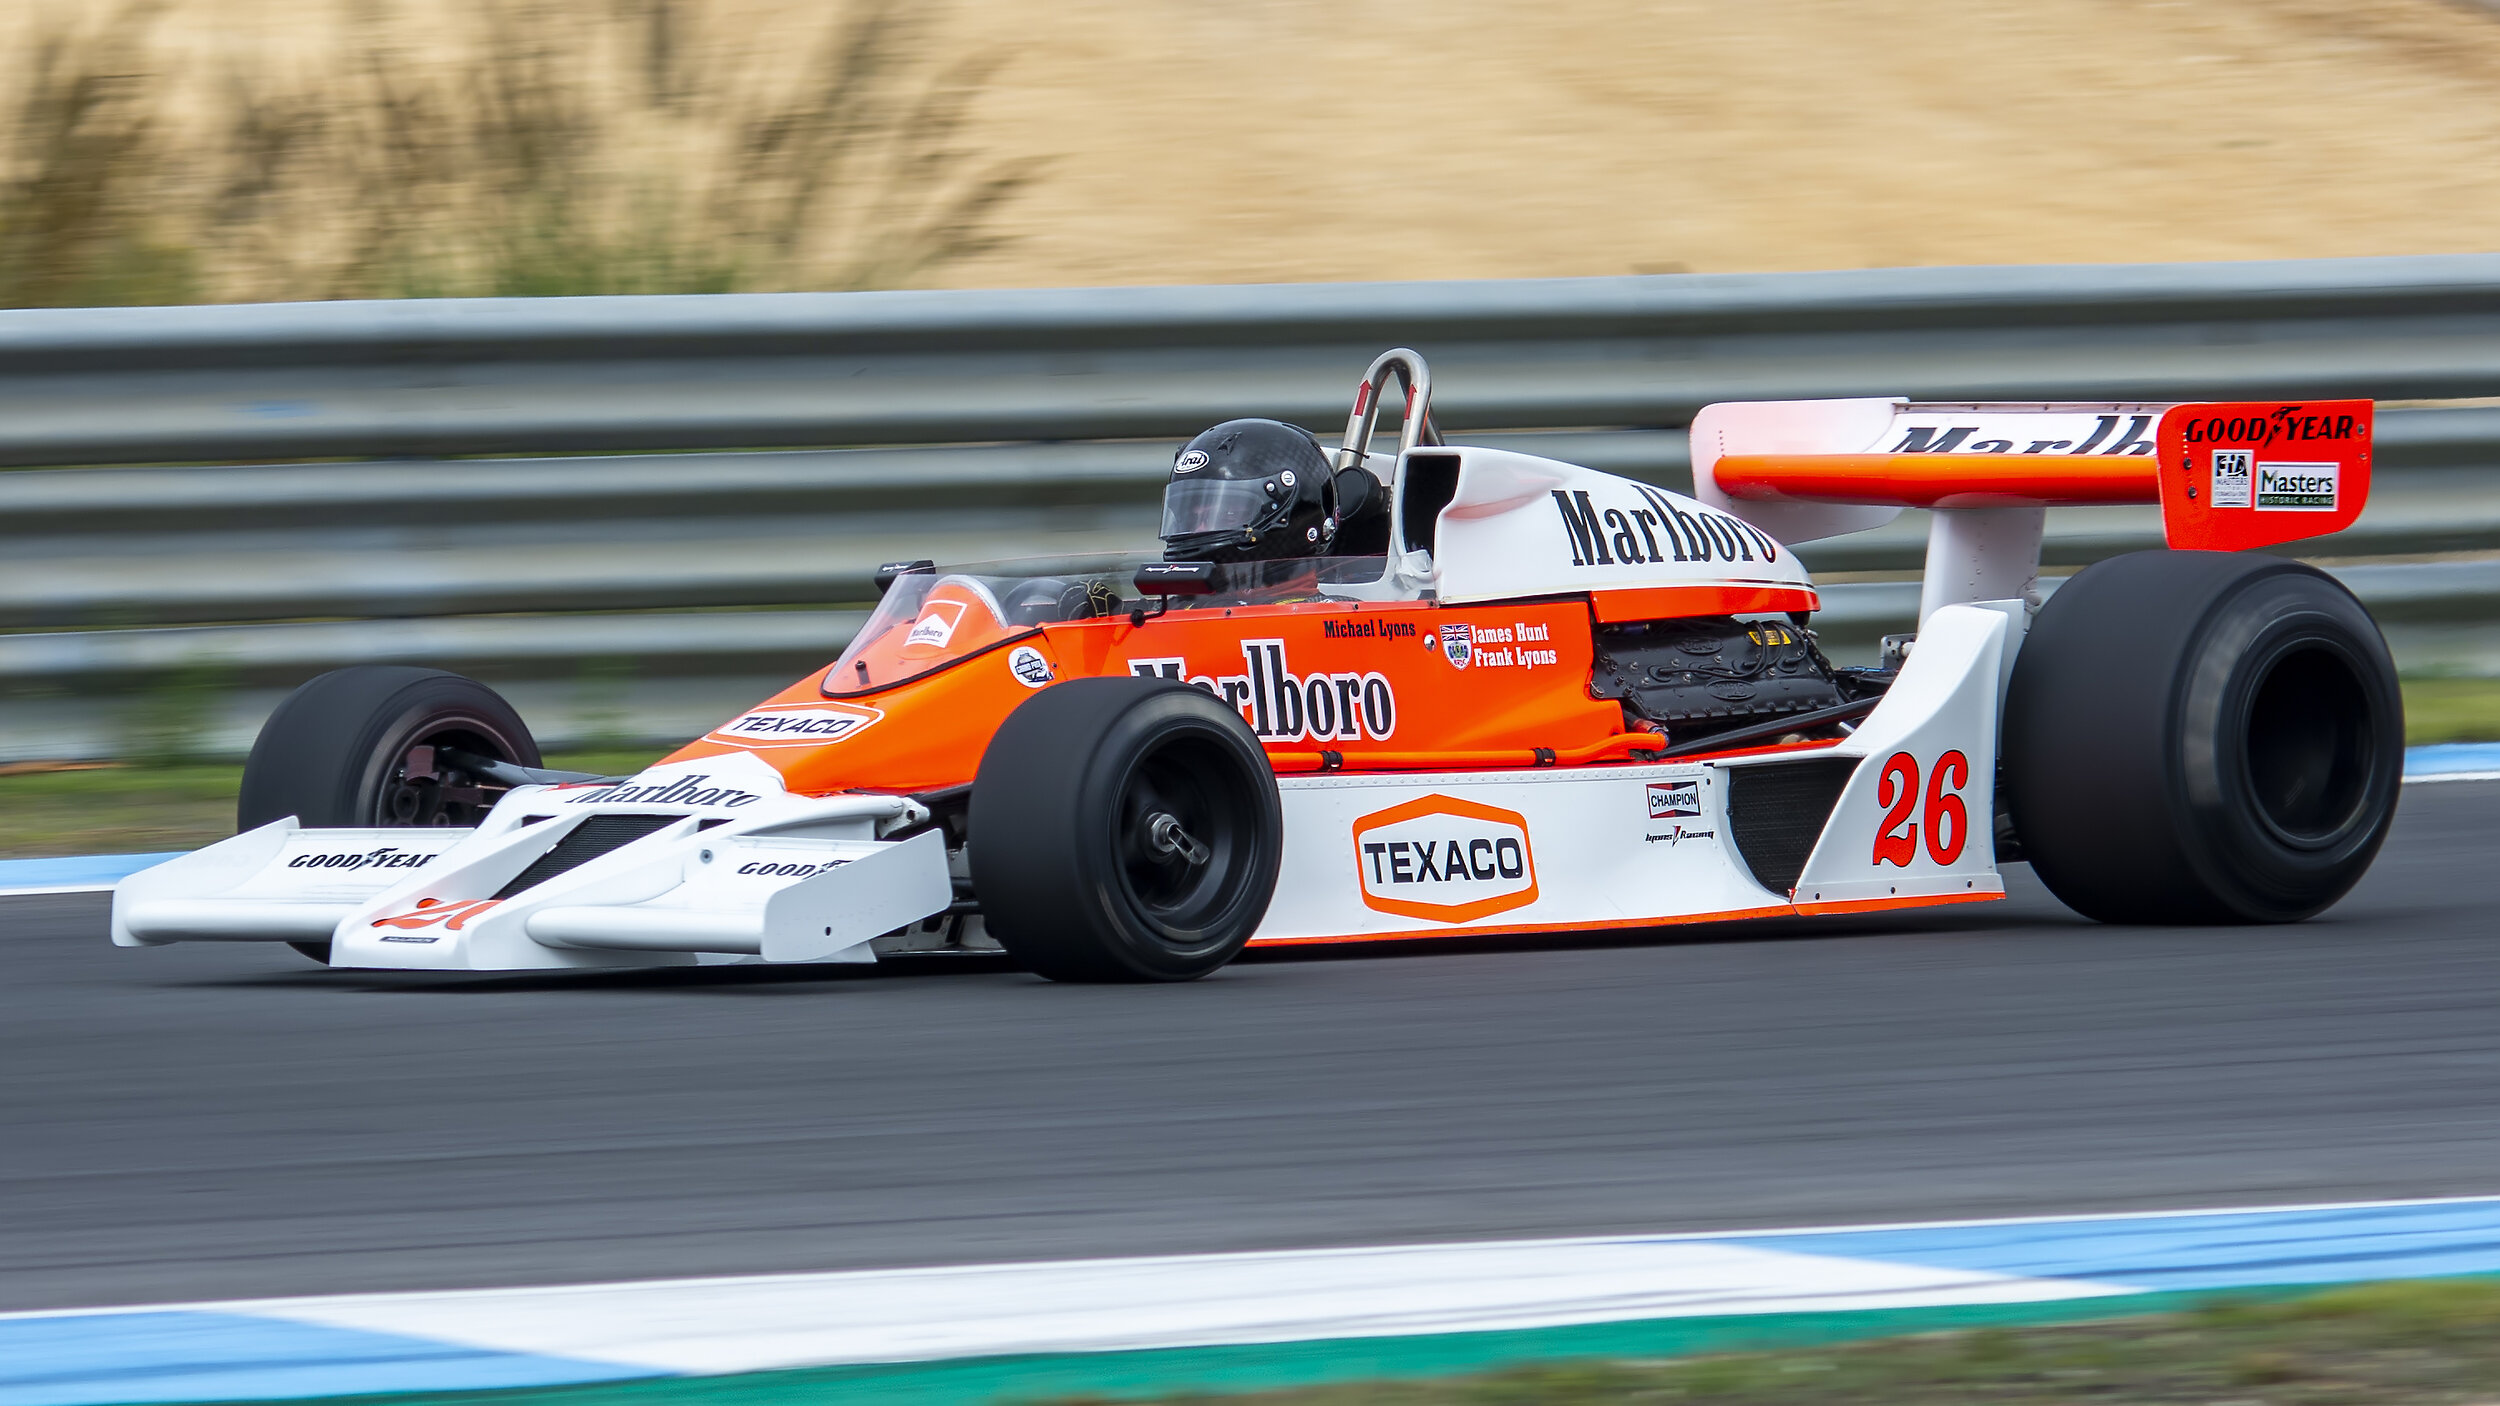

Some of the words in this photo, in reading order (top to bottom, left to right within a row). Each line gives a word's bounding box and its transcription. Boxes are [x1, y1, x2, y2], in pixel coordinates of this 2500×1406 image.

[2262, 469, 2333, 492] Masters
[1551, 484, 1776, 566] Marlboro
[1324, 619, 1374, 638] Michael
[1379, 619, 1416, 641] Lyons
[1471, 625, 1512, 643] James
[1515, 623, 1549, 642] Hunt
[1474, 647, 1513, 667] Frank
[1516, 647, 1557, 670] Lyons
[1130, 641, 1394, 740] rlboro
[731, 716, 856, 734] TEXACO
[564, 775, 762, 808] Marlboro
[1650, 793, 1697, 807] CHAMPION
[1873, 749, 1968, 867] 26
[1364, 837, 1524, 884] TEXACO
